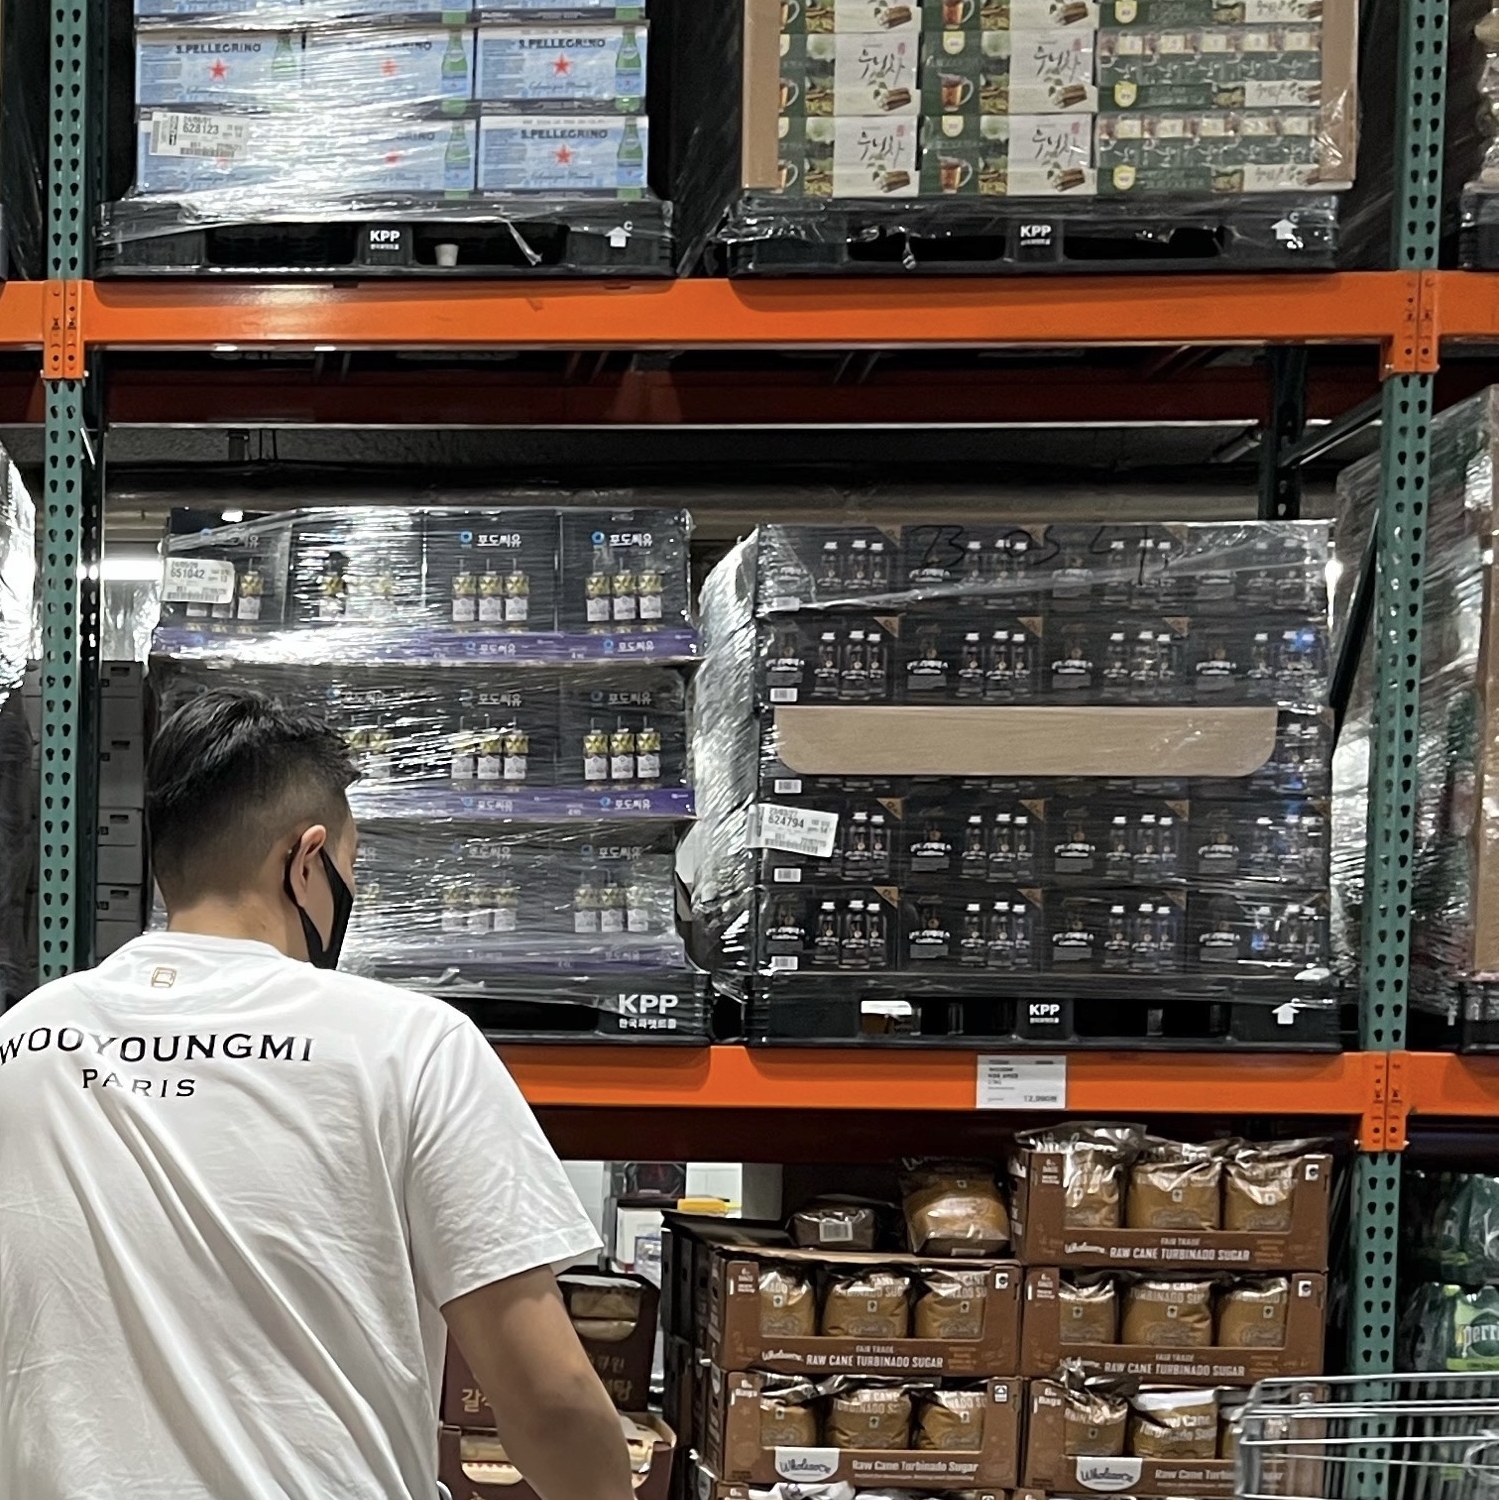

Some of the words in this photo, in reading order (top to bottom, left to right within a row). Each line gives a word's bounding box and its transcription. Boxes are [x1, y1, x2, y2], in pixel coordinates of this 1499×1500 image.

[521, 129, 608, 139] S.PELLEGRINO
[370, 230, 400, 242] KPP
[1020, 225, 1051, 237] KPP
[478, 534, 522, 547] 포도씨유
[610, 533, 652, 547] 포도씨유
[618, 994, 678, 1014] KPP
[1029, 1004, 1060, 1016] KPP
[82, 1069, 196, 1098] PARIS
[1110, 1247, 1131, 1259] RAW
[1133, 1248, 1158, 1259] CANE
[1161, 1248, 1216, 1260] TURBINADO
[1218, 1249, 1250, 1261] SUGAR
[1463, 1321, 1499, 1358] perri
[806, 1354, 827, 1366] RAW
[829, 1355, 853, 1366] CANE
[856, 1355, 910, 1367] TURBINADO
[912, 1357, 943, 1368] SUGAR
[1104, 1361, 1126, 1373] RAW
[1128, 1362, 1153, 1374] CANE
[1156, 1363, 1211, 1376] TURBINADO
[1212, 1364, 1245, 1377] SUGAR
[852, 1460, 872, 1470] Raw
[874, 1461, 899, 1471] Cane
[901, 1461, 946, 1472] Turbinado
[948, 1462, 979, 1474] Sugar
[1155, 1469, 1176, 1479] Raw
[1179, 1470, 1204, 1479] Cane
